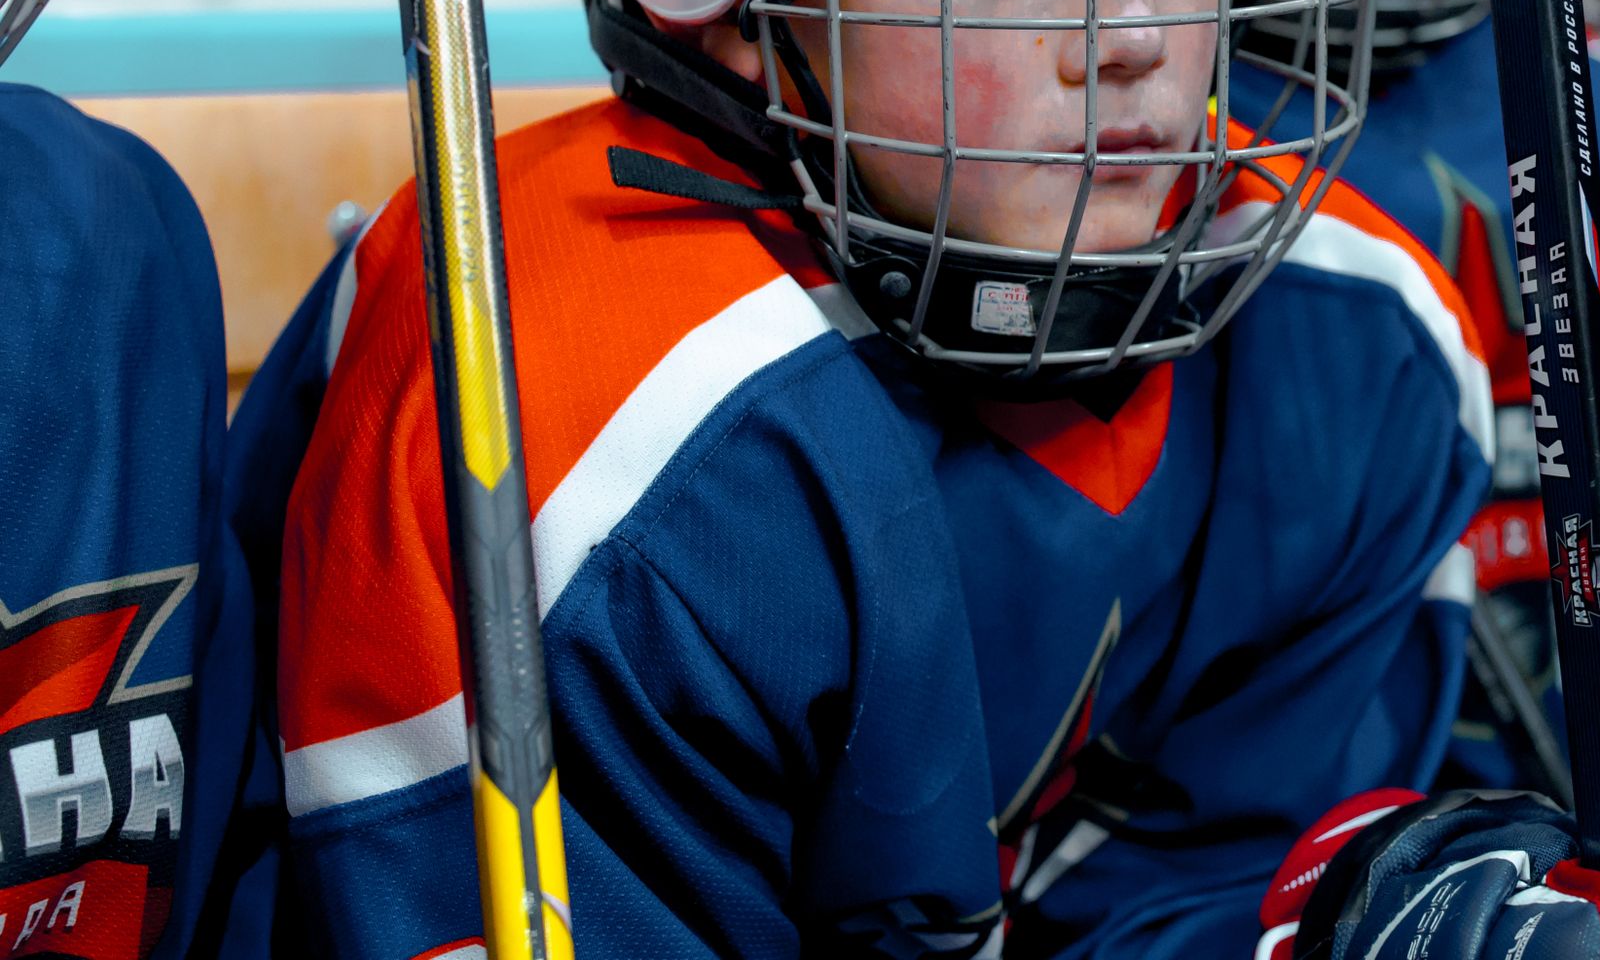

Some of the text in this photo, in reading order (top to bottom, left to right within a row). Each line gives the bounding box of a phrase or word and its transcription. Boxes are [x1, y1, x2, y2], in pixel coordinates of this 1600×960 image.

[1569, 60, 1582, 75] В
[1571, 80, 1592, 177] СДЕЛАНО
[1564, 516, 1590, 624] КРАСНАЯ
